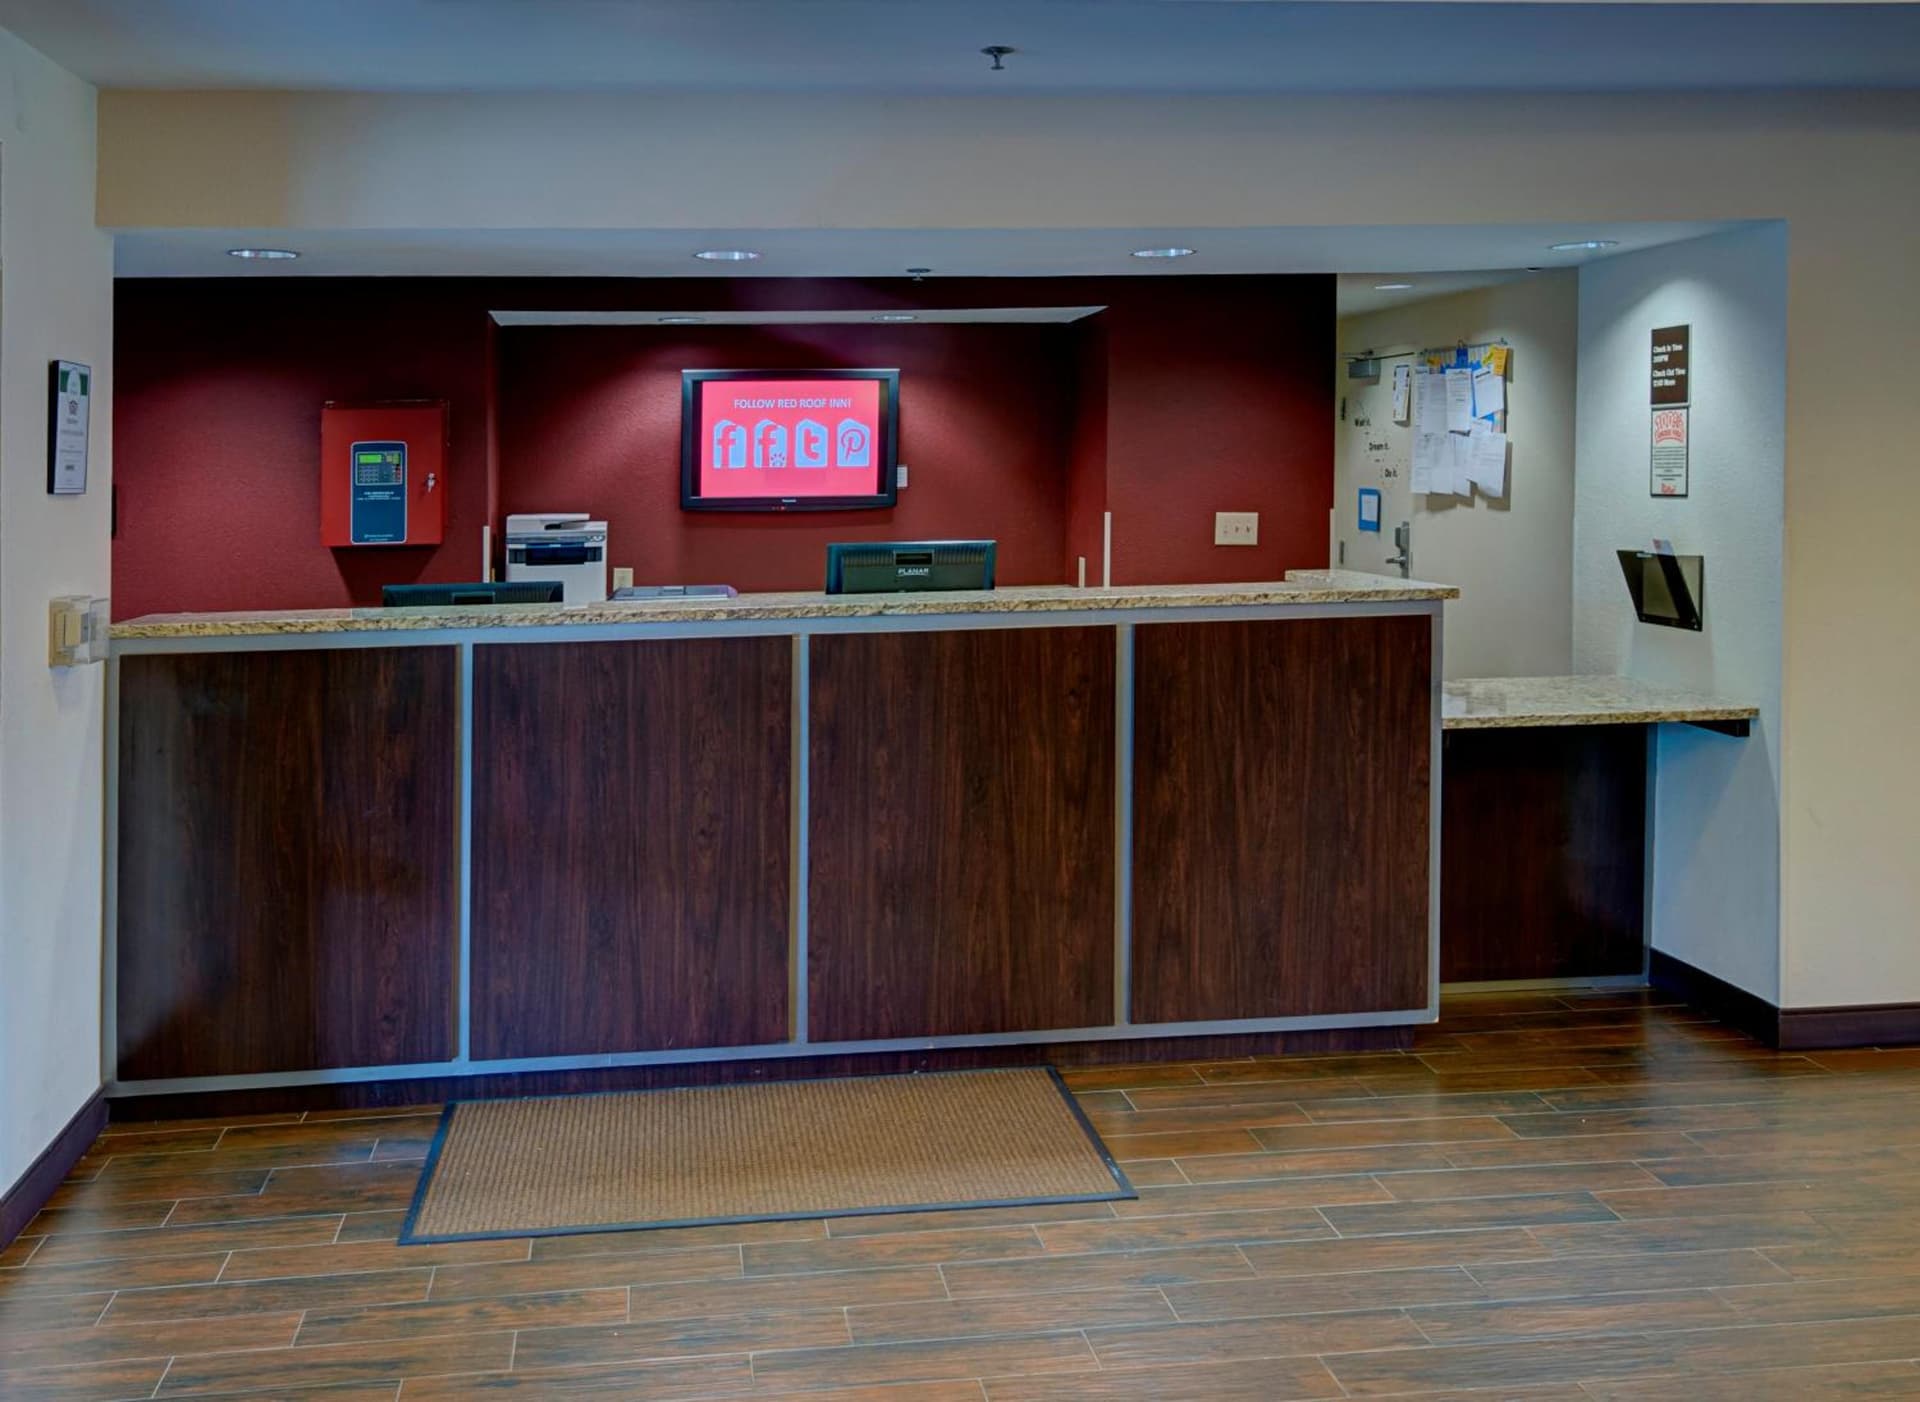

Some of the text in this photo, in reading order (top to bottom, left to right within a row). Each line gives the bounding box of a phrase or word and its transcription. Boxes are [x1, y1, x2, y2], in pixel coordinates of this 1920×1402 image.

[733, 398, 852, 409] FOLLOW RED ROOF INN!
[897, 567, 929, 576] PLANAR
